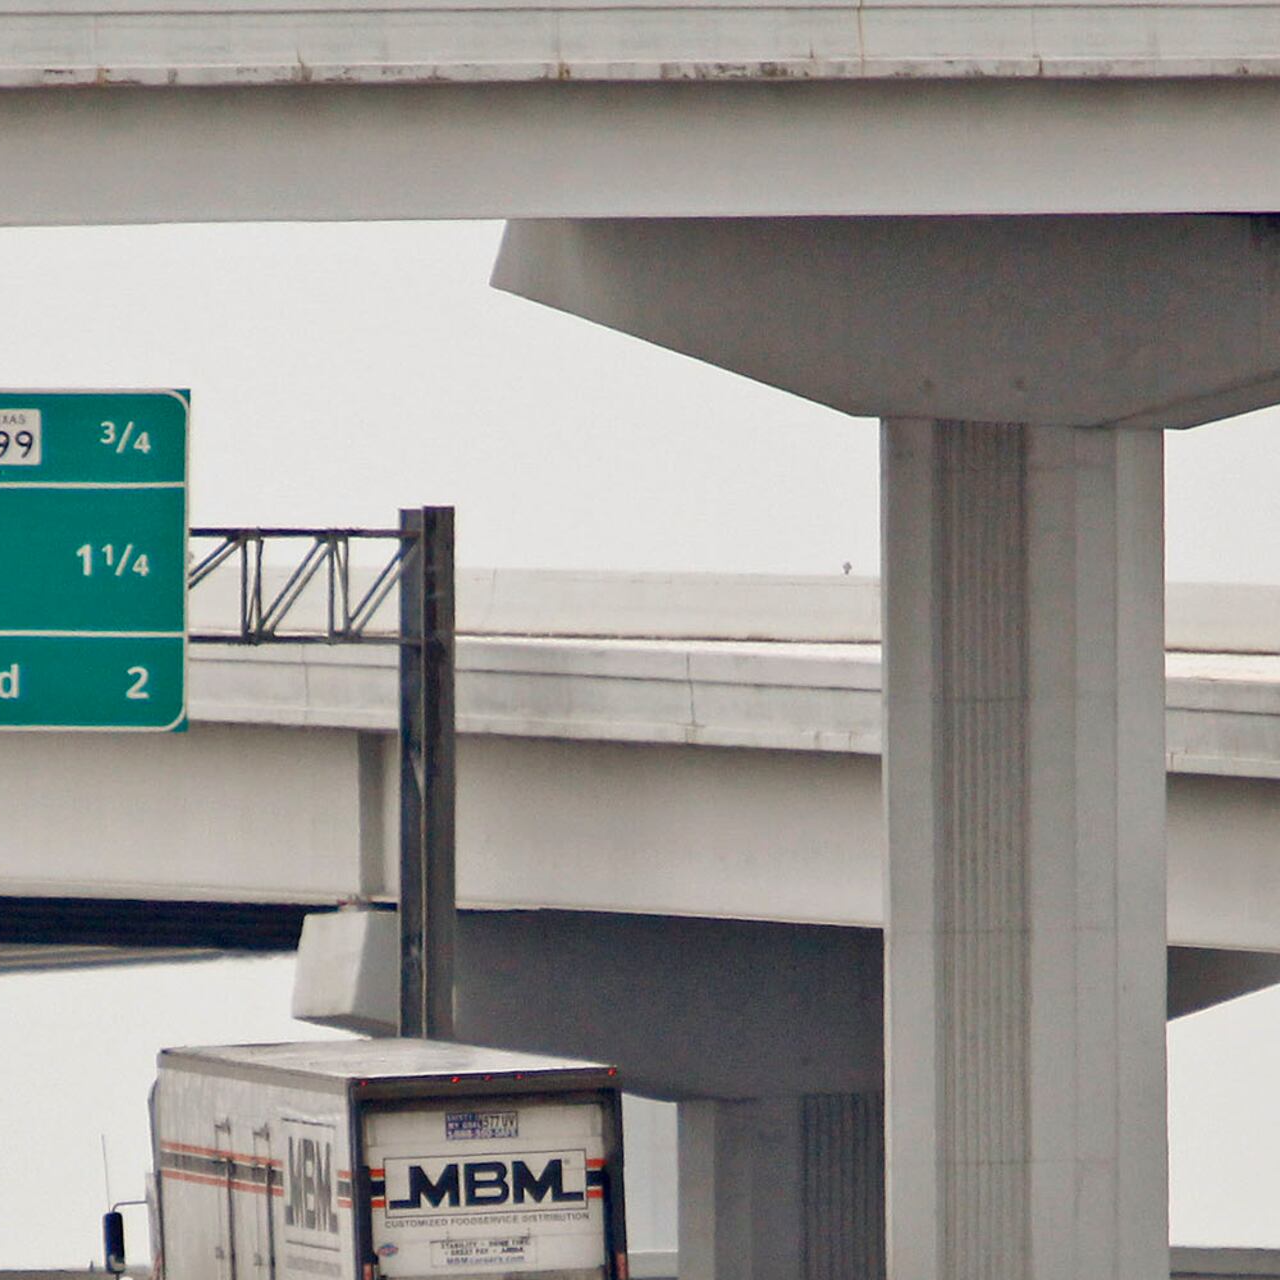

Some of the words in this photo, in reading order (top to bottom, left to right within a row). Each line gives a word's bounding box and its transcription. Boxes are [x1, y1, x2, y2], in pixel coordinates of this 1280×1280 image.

[125, 666, 150, 700] 2
[286, 1135, 339, 1234] MBM
[388, 1158, 585, 1210] MBM
[384, 1217, 449, 1229] CUSTOMIZED
